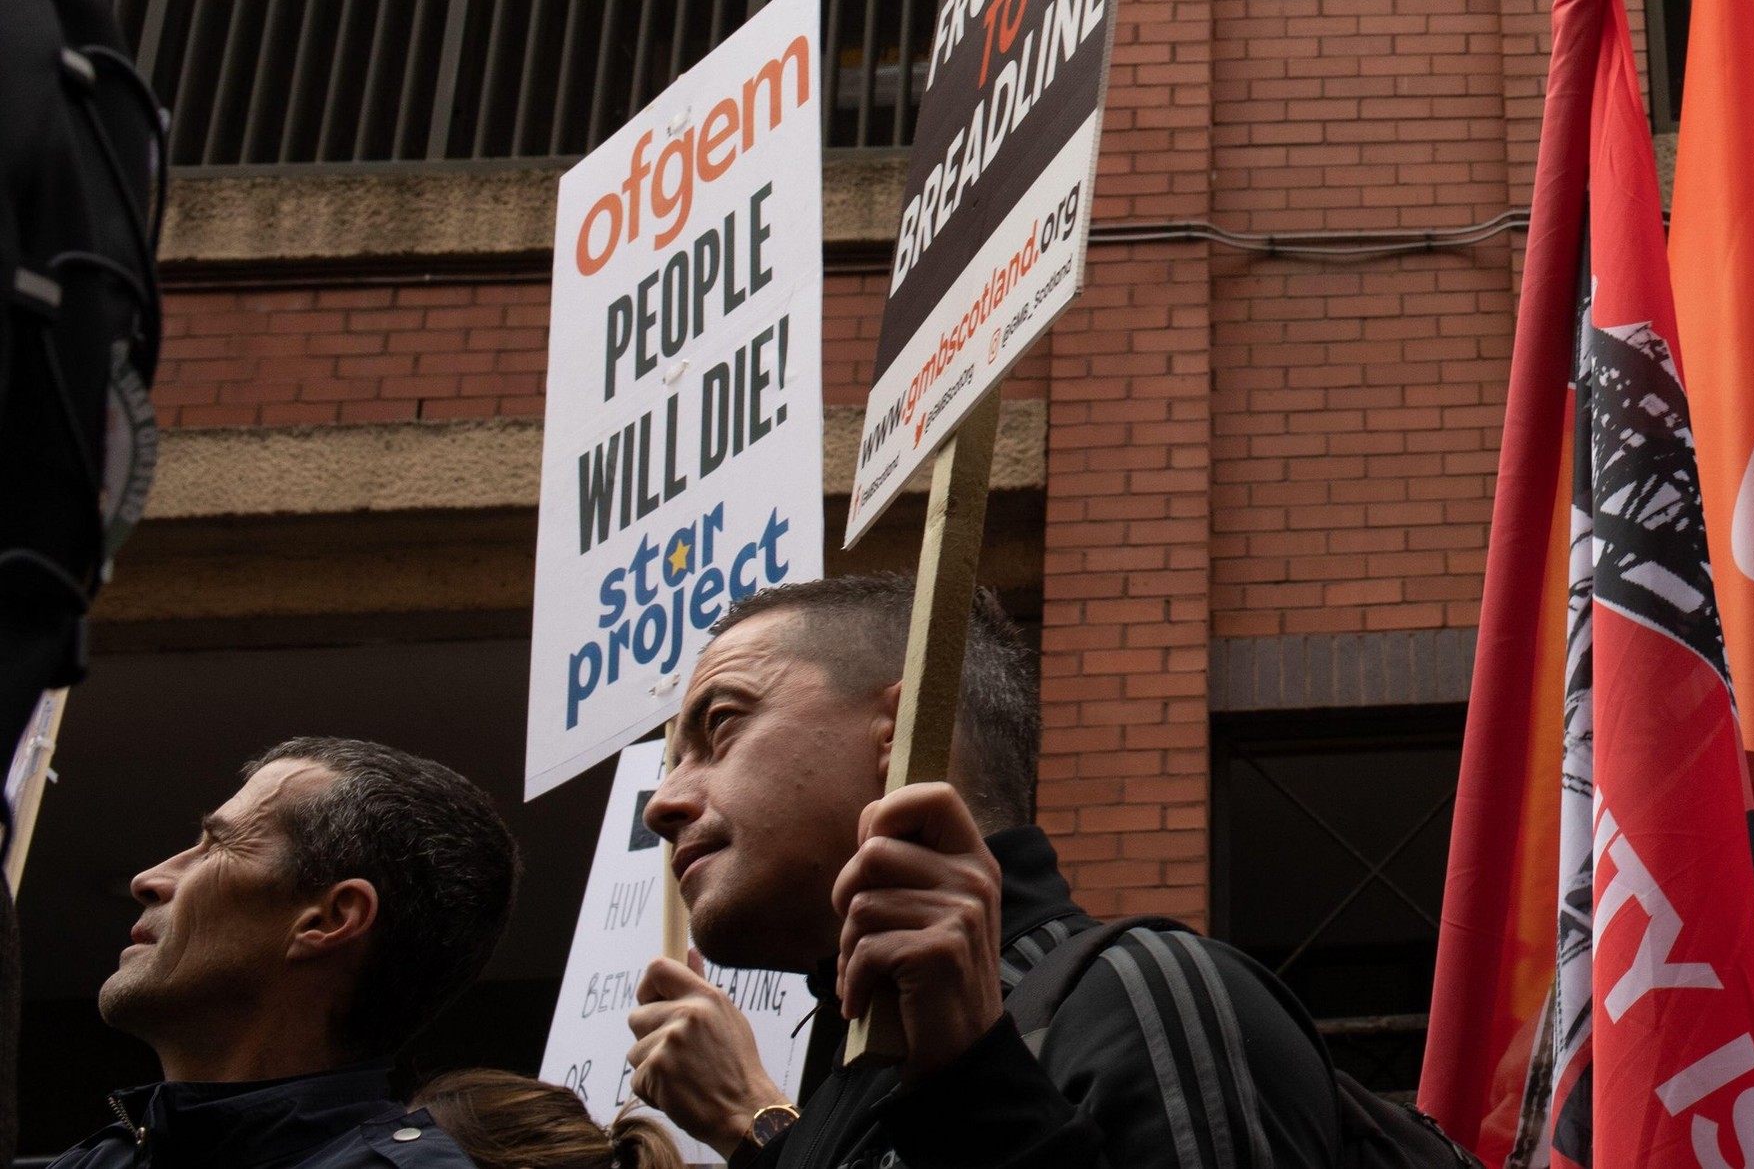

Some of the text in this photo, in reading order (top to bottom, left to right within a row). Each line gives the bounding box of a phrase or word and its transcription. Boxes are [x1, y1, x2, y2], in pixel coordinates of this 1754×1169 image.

[575, 35, 811, 277] ofgem
[604, 181, 773, 403] PEOPLE
[860, 180, 1081, 469] www.gmbscotland.org
[578, 314, 790, 555] WILL DIE!
[566, 506, 790, 731] project
[598, 501, 724, 629] star
